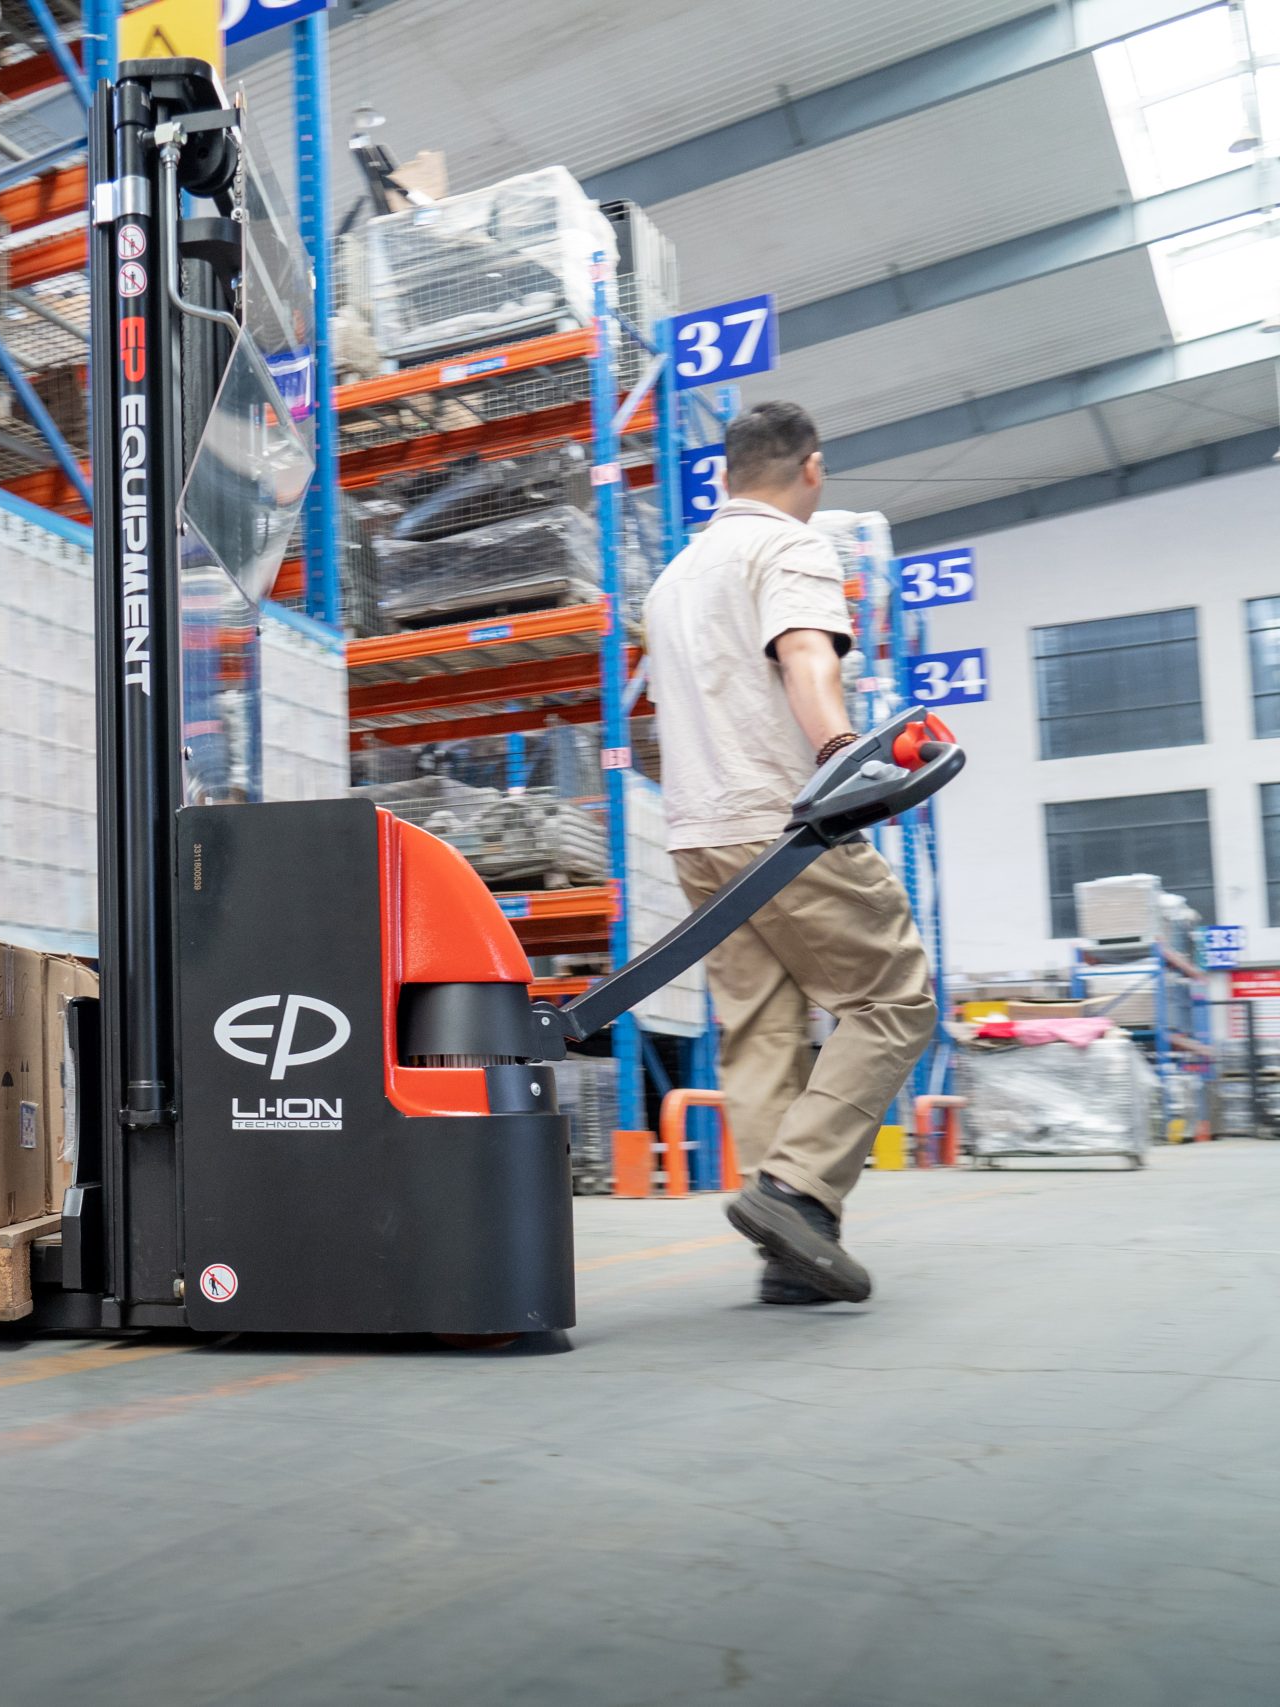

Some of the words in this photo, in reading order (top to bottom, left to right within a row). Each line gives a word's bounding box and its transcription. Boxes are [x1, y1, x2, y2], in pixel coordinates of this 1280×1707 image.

[120, 316, 146, 382] EP
[676, 308, 768, 377] 37
[691, 456, 729, 511] 3
[120, 394, 150, 696] EQUIPMENT
[900, 557, 974, 602] 35
[913, 657, 988, 700] 34
[213, 994, 351, 1080] EP
[232, 1097, 342, 1118] LI-ION
